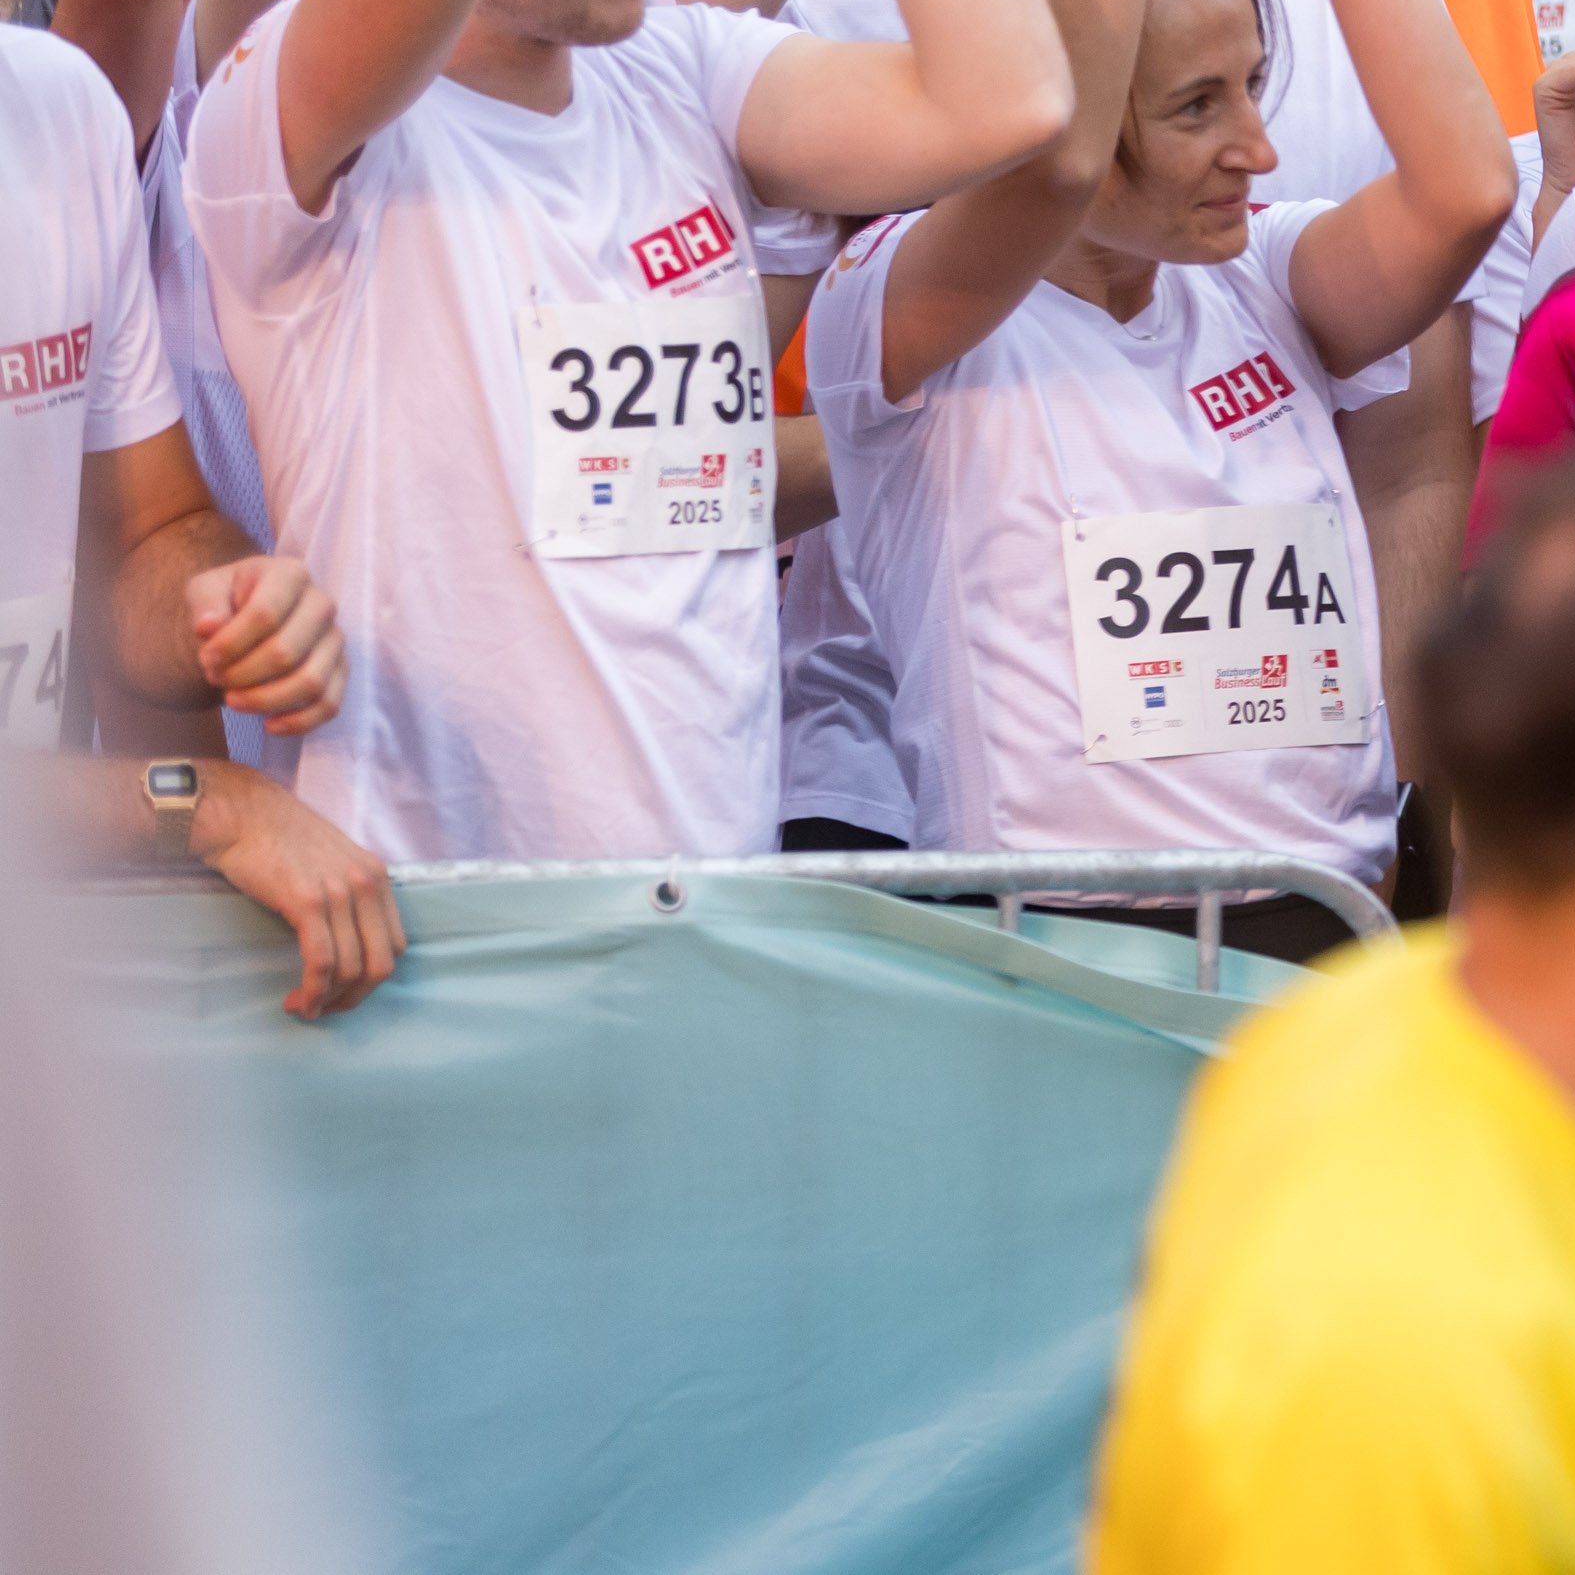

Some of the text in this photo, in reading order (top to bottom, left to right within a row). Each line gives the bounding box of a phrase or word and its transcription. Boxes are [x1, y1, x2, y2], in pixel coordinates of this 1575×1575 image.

[640, 215, 722, 281] RH
[668, 499, 722, 525] 2025
[1095, 544, 1346, 639] 3274A
[1228, 698, 1287, 726] 2025
